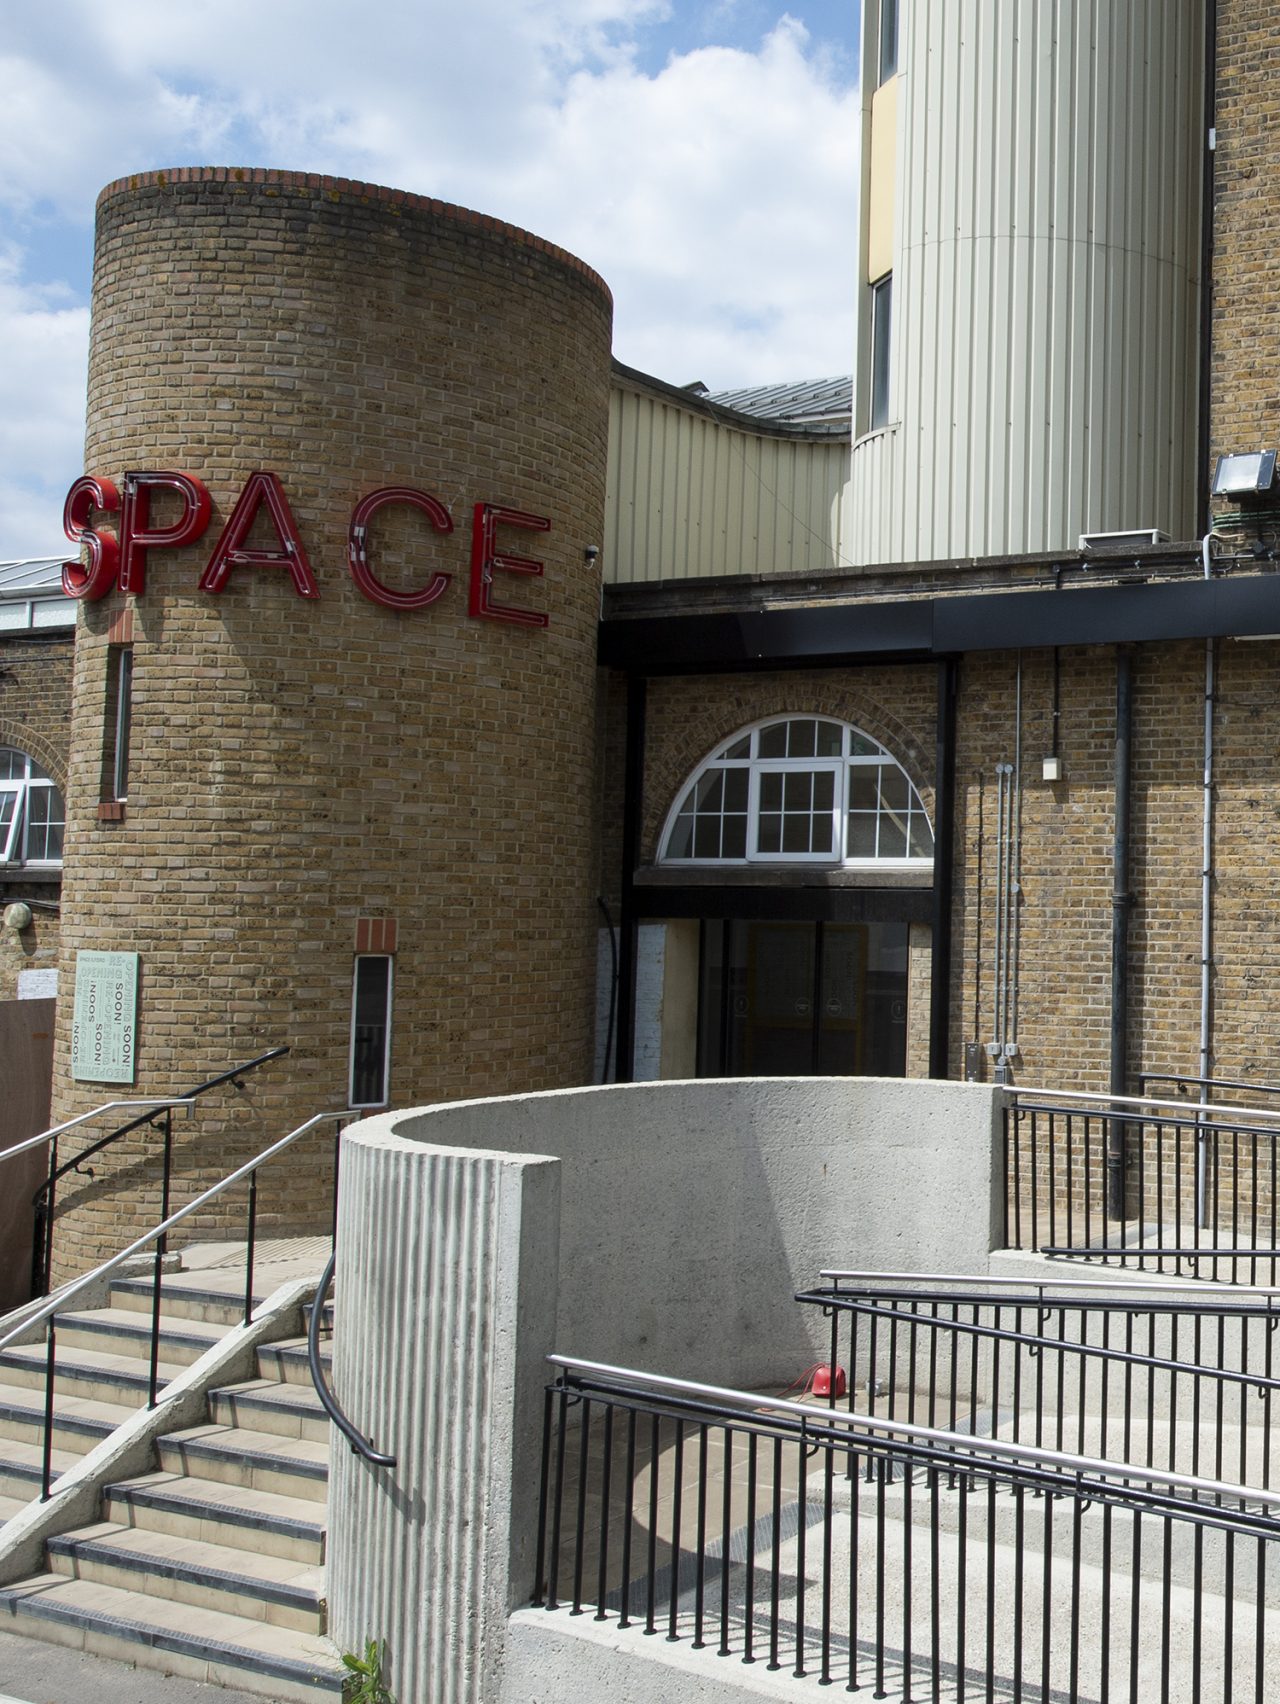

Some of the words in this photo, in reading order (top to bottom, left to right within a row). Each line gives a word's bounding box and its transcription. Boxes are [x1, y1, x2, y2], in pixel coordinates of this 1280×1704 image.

[61, 471, 552, 627] SPACE
[88, 981, 96, 1022] SOON!
[114, 982, 124, 1024] SOON!
[123, 960, 135, 1022] OPENING
[94, 1023, 103, 1066] SOON!
[122, 1025, 132, 1067] SOON!
